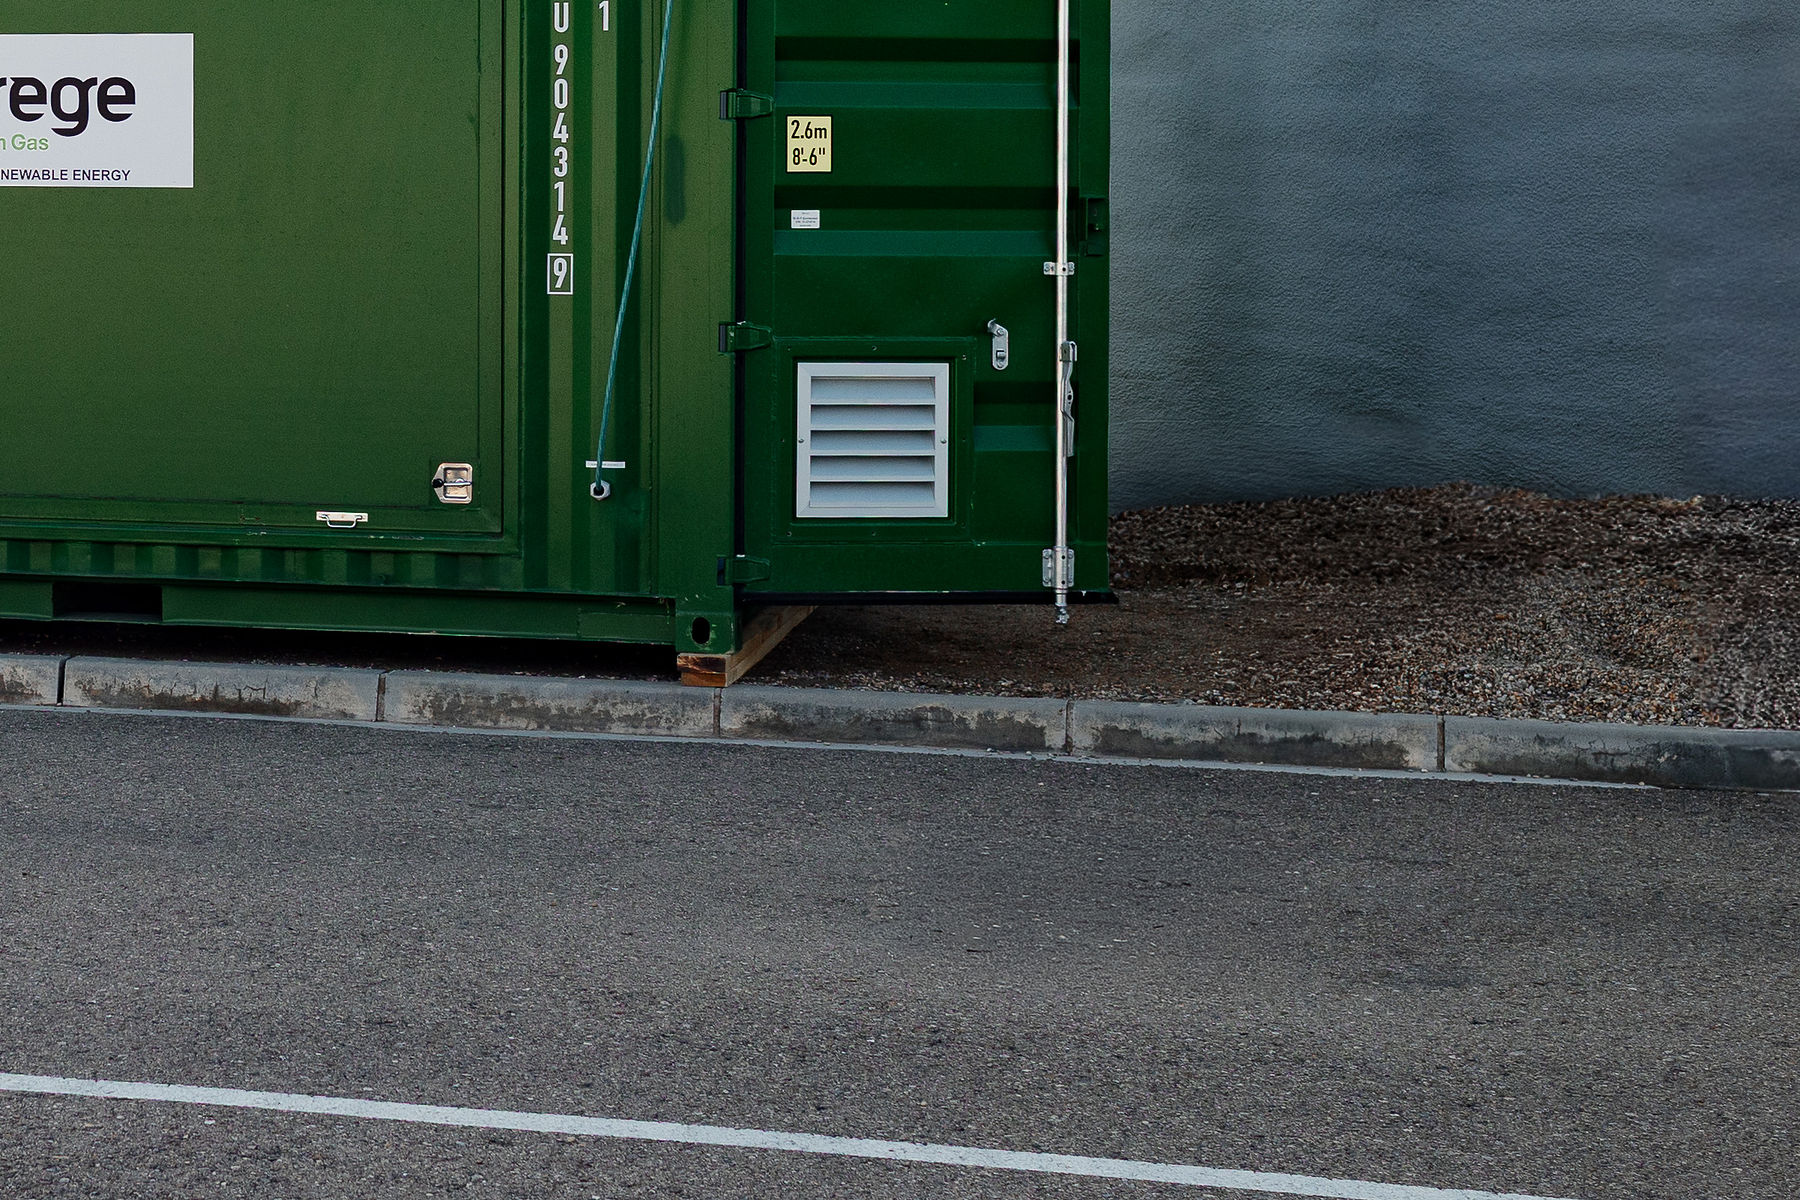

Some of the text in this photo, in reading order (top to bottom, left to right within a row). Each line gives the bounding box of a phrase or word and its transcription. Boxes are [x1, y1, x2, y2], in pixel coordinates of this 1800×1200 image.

[791, 119, 827, 139] 2.6m
[11, 133, 49, 150] Gas
[552, 44, 569, 246] 904314
[792, 147, 826, 166] 8'-6"
[73, 169, 131, 181] ENERGY
[553, 257, 568, 289] 9
